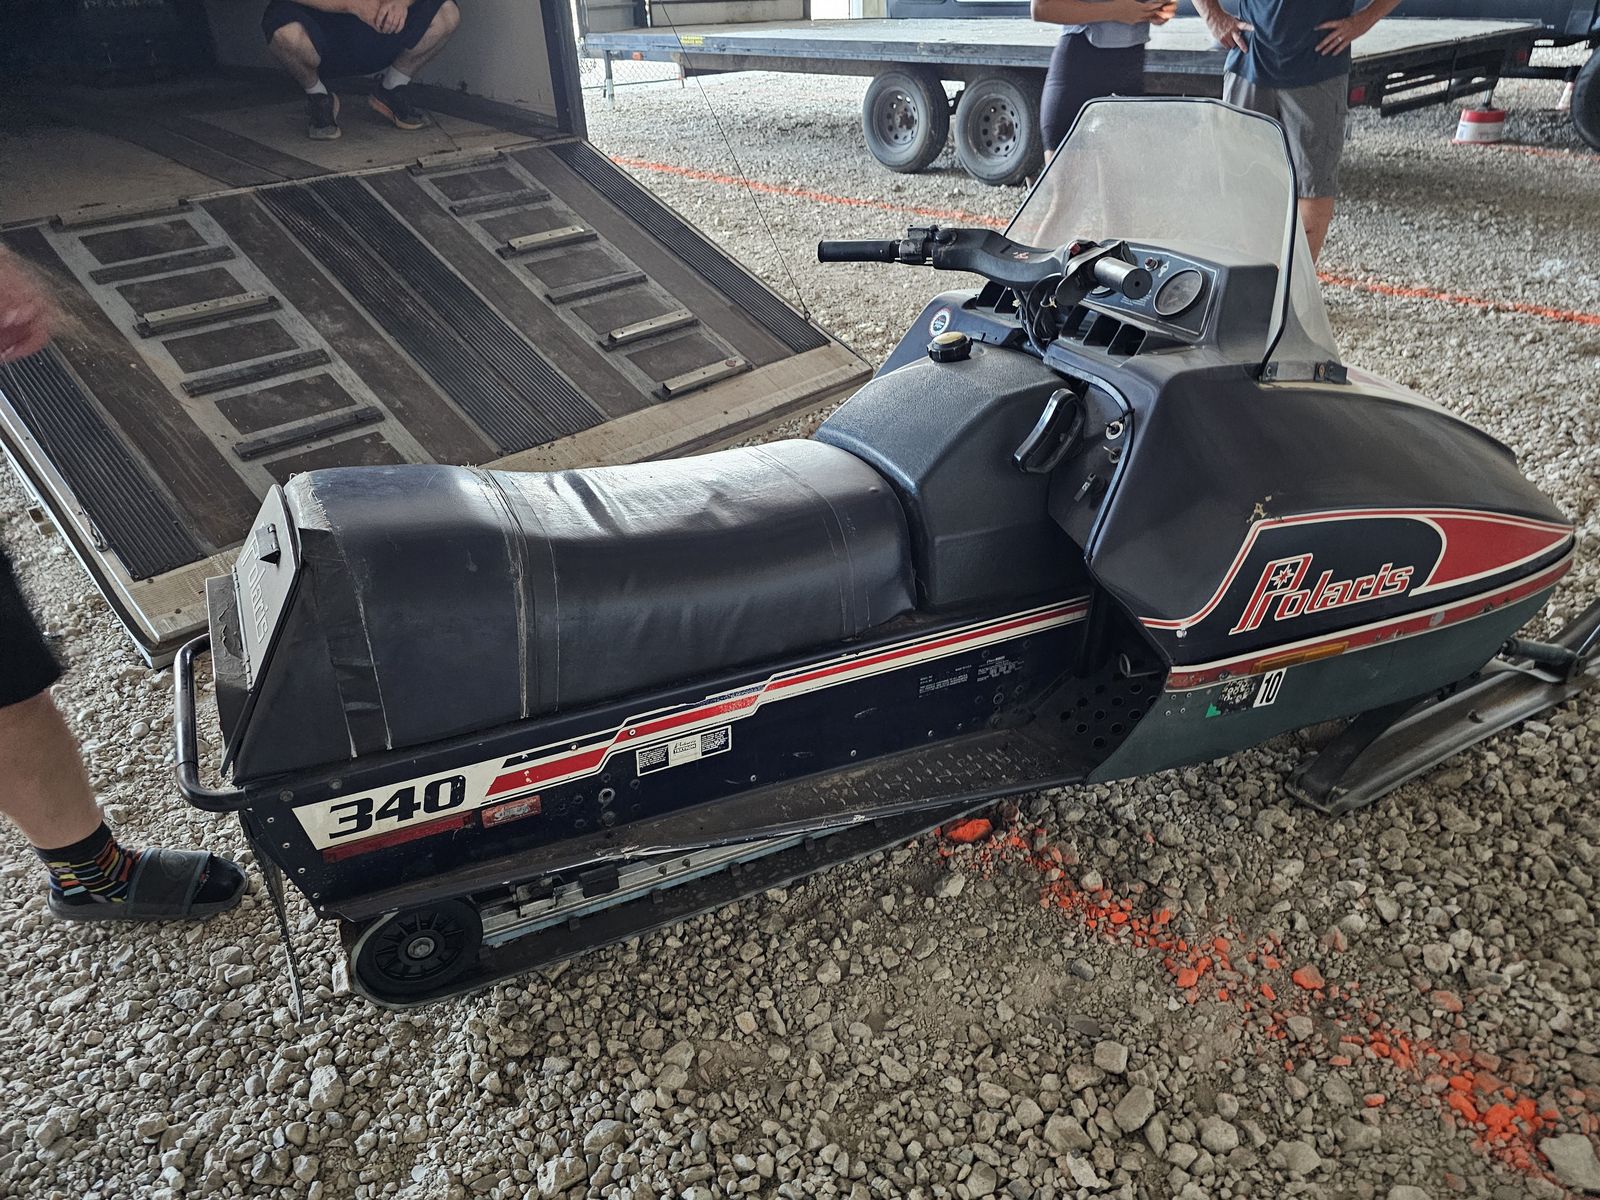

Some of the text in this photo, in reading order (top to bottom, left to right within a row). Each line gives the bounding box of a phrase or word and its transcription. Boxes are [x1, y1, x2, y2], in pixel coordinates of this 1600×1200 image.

[1228, 553, 1415, 635] Polaris
[1260, 671, 1283, 704] 10
[328, 774, 467, 839] 340
